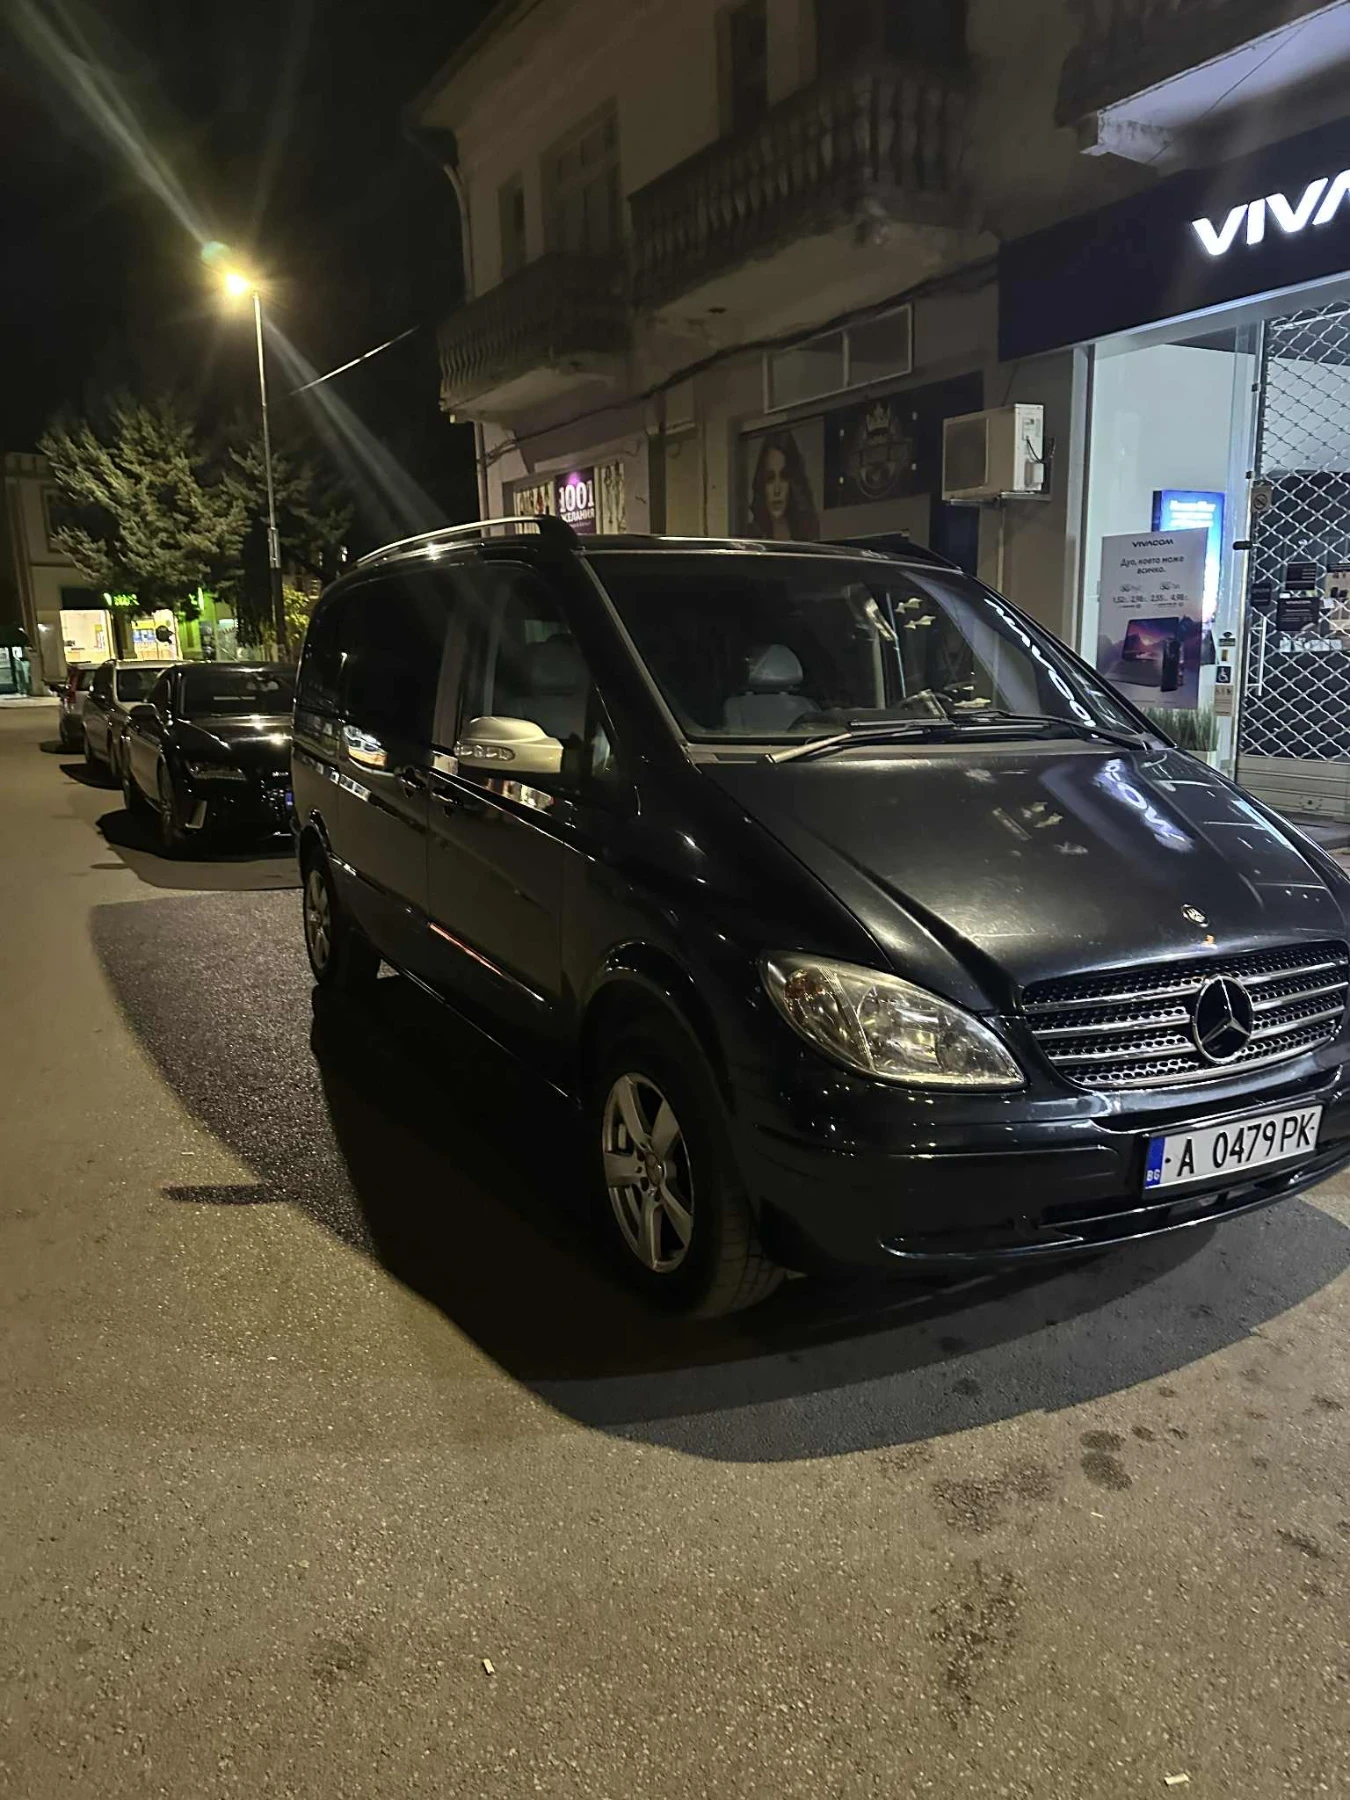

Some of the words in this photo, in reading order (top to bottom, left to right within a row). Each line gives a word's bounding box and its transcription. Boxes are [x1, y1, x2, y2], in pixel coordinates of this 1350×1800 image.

[559, 480, 595, 513] 1001
[1132, 539, 1174, 548] VIVACOM
[1177, 1138, 1195, 1177] A
[1146, 1169, 1161, 1182] BG
